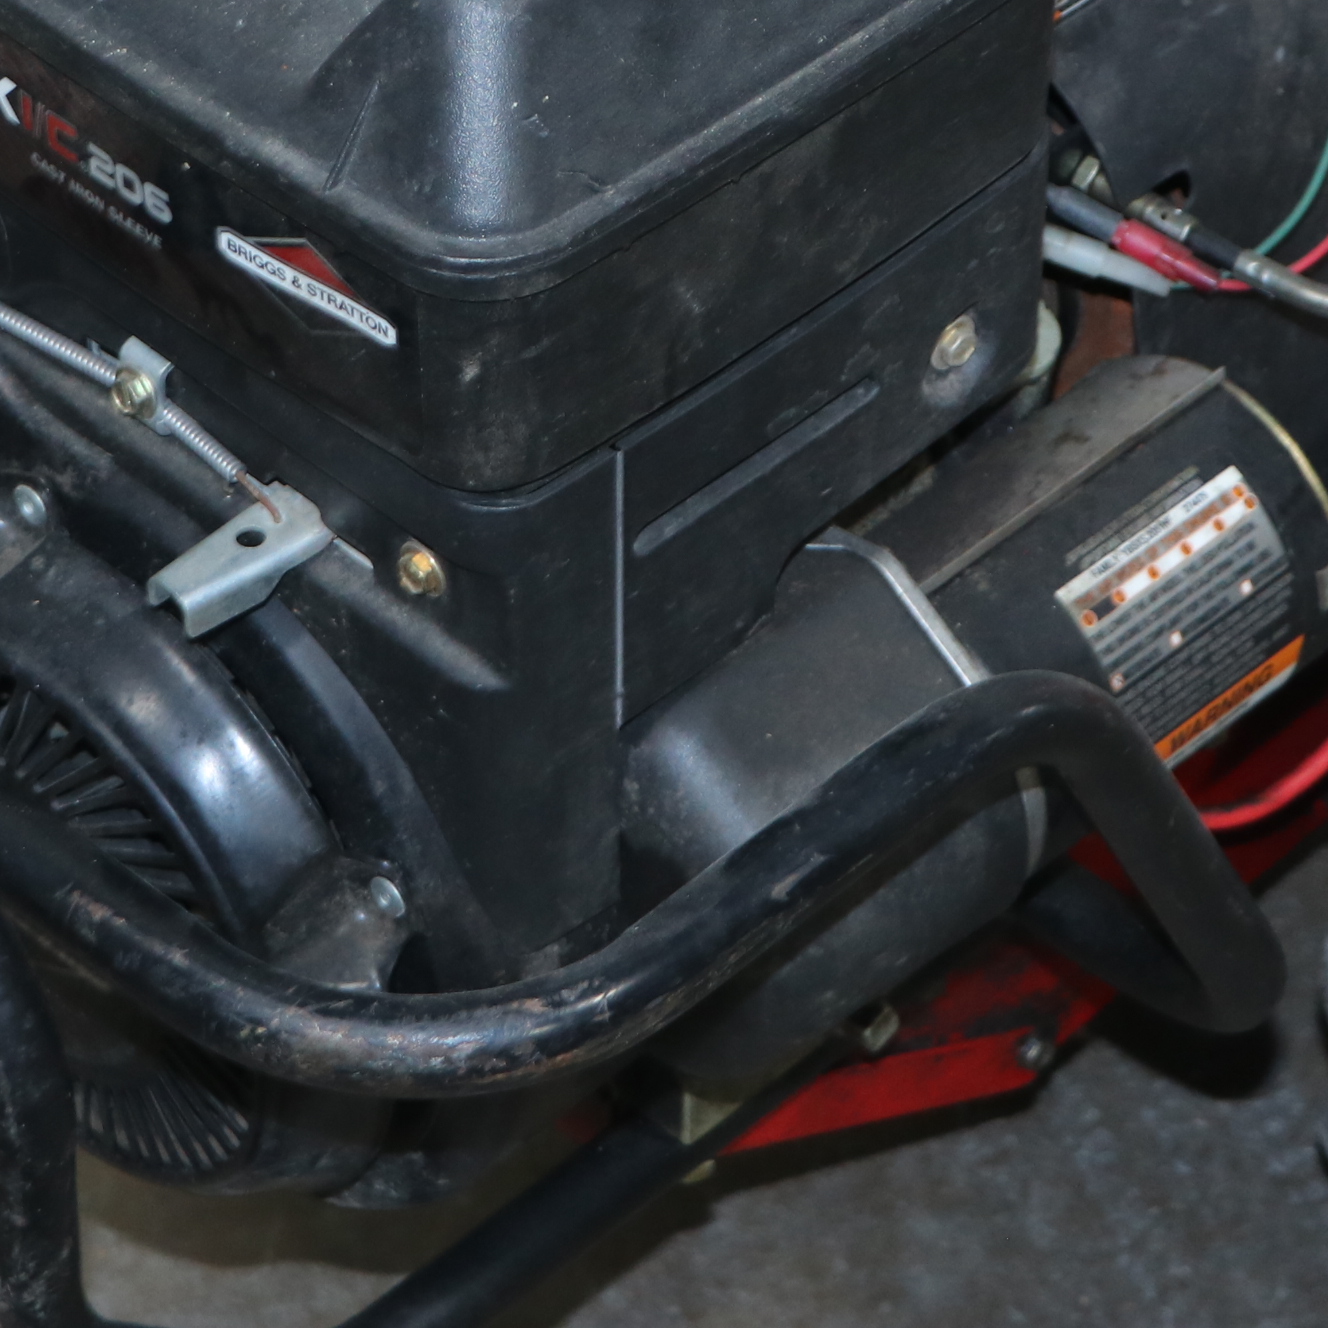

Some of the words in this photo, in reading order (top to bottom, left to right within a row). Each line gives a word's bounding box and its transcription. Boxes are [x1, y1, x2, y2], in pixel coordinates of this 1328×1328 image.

[30, 151, 66, 185] CAST
[71, 178, 105, 211] IRON
[108, 206, 163, 250] SLEEVE
[86, 141, 173, 224] 206
[227, 237, 287, 281] BRIGGS
[292, 275, 302, 289] &
[306, 283, 389, 338] STRATTON
